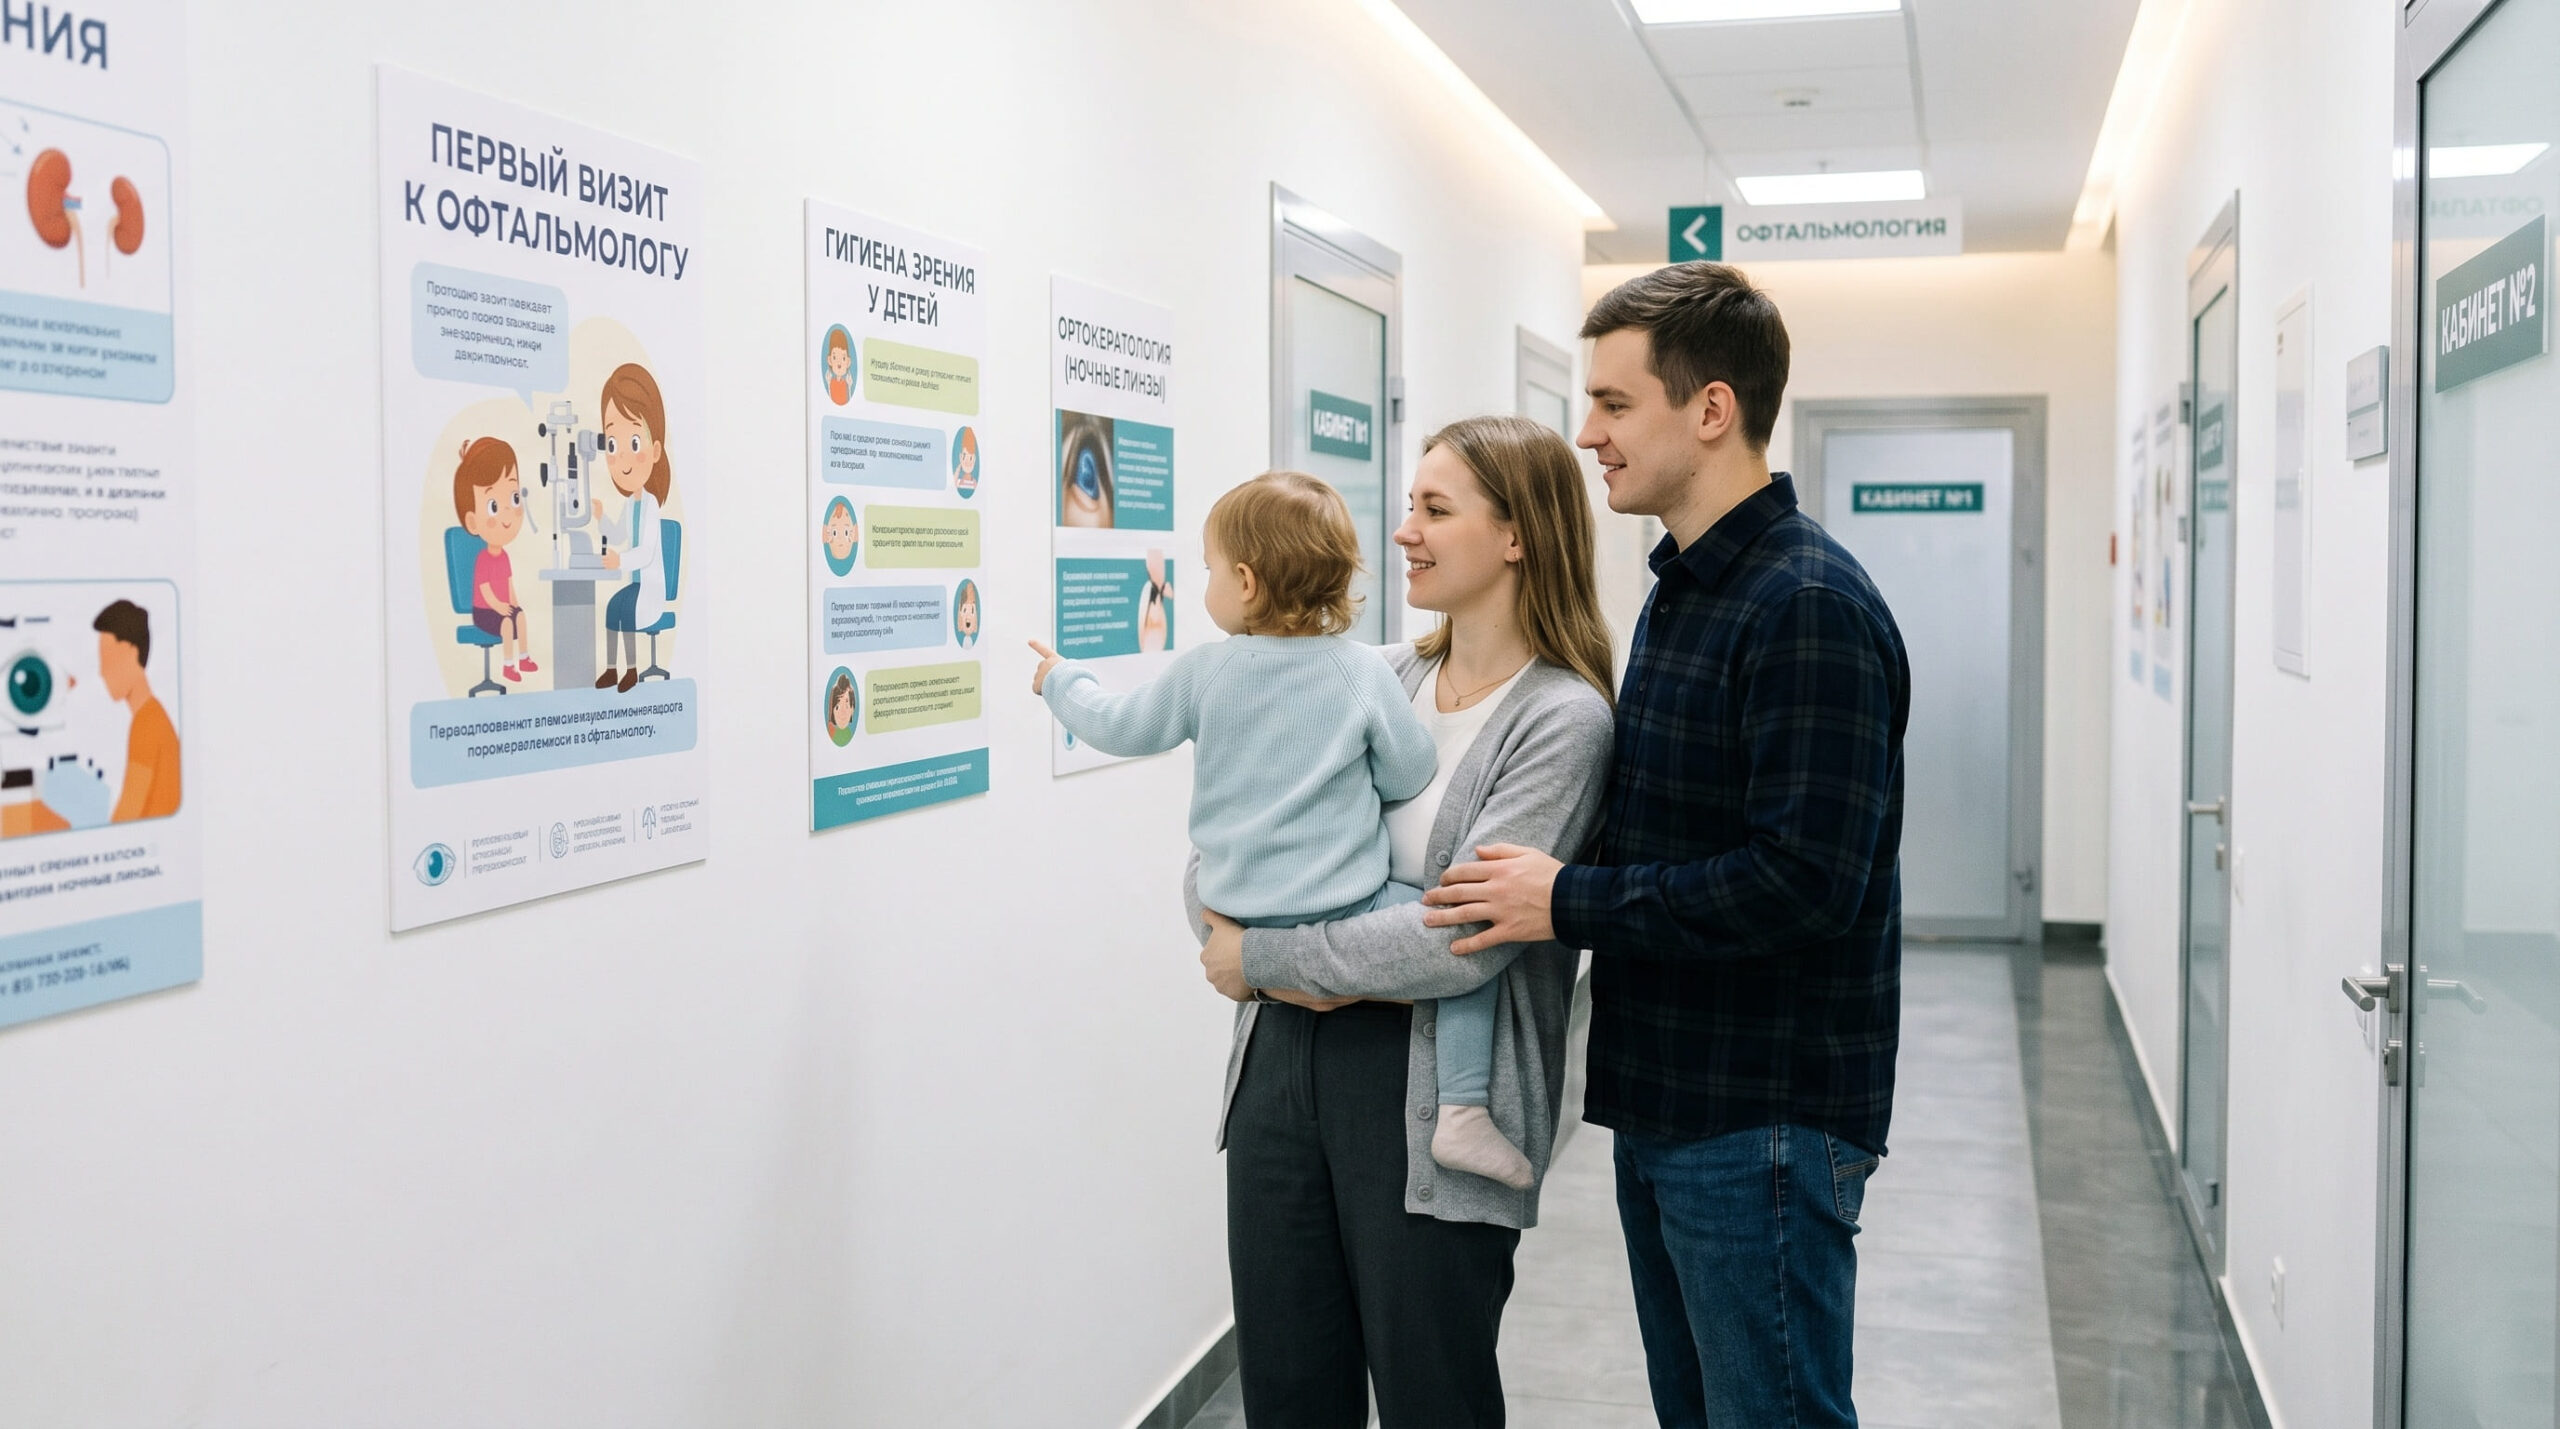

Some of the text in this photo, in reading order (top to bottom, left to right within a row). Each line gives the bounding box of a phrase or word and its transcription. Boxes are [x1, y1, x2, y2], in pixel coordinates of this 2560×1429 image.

[2, 0, 108, 70] НИЯ
[431, 122, 669, 222] ПЕРВЫЙ ВИЗИТ
[405, 179, 689, 281] К ОФТАЛЬМОЛОГУ
[1736, 216, 1948, 243] ОФТАЛЬМОЛОГИЯ
[825, 226, 975, 295] ГИГИЕНА ЗРЕНИЯ
[867, 283, 938, 327] У ДЕТЕЙ
[2441, 263, 2536, 356] КАБИНЕТ №2
[1058, 316, 1171, 364] ОРТОКЕРАТОЛОГИЯ
[1065, 354, 1165, 404] (НОЧНЫЕ ЛИНЗЫ)
[1860, 488, 1941, 509] КАБИНЕТ
